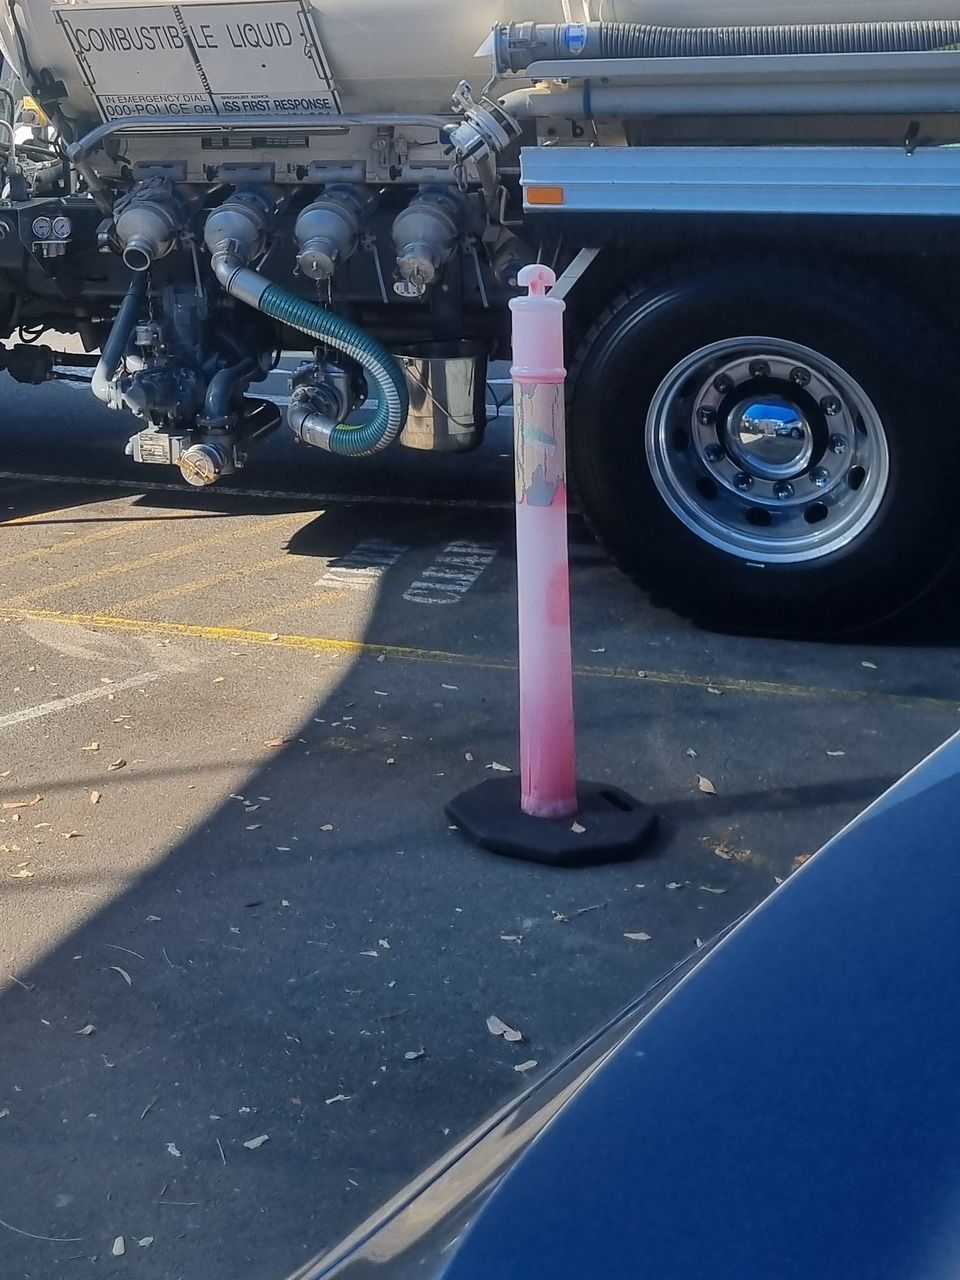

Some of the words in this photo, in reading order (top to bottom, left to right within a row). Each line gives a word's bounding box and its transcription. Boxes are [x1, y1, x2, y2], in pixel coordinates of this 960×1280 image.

[75, 24, 219, 53] COMBUSTIBLE
[226, 22, 293, 49] LIQUID
[105, 96, 115, 104] IN
[117, 94, 181, 104] EMERGENCY
[183, 93, 207, 103] DIAL
[222, 101, 241, 112] ISS
[242, 100, 272, 112] FIRST
[274, 98, 332, 111] RESPONSE
[106, 103, 191, 116] 000-POLICE
[194, 104, 214, 114] OR
